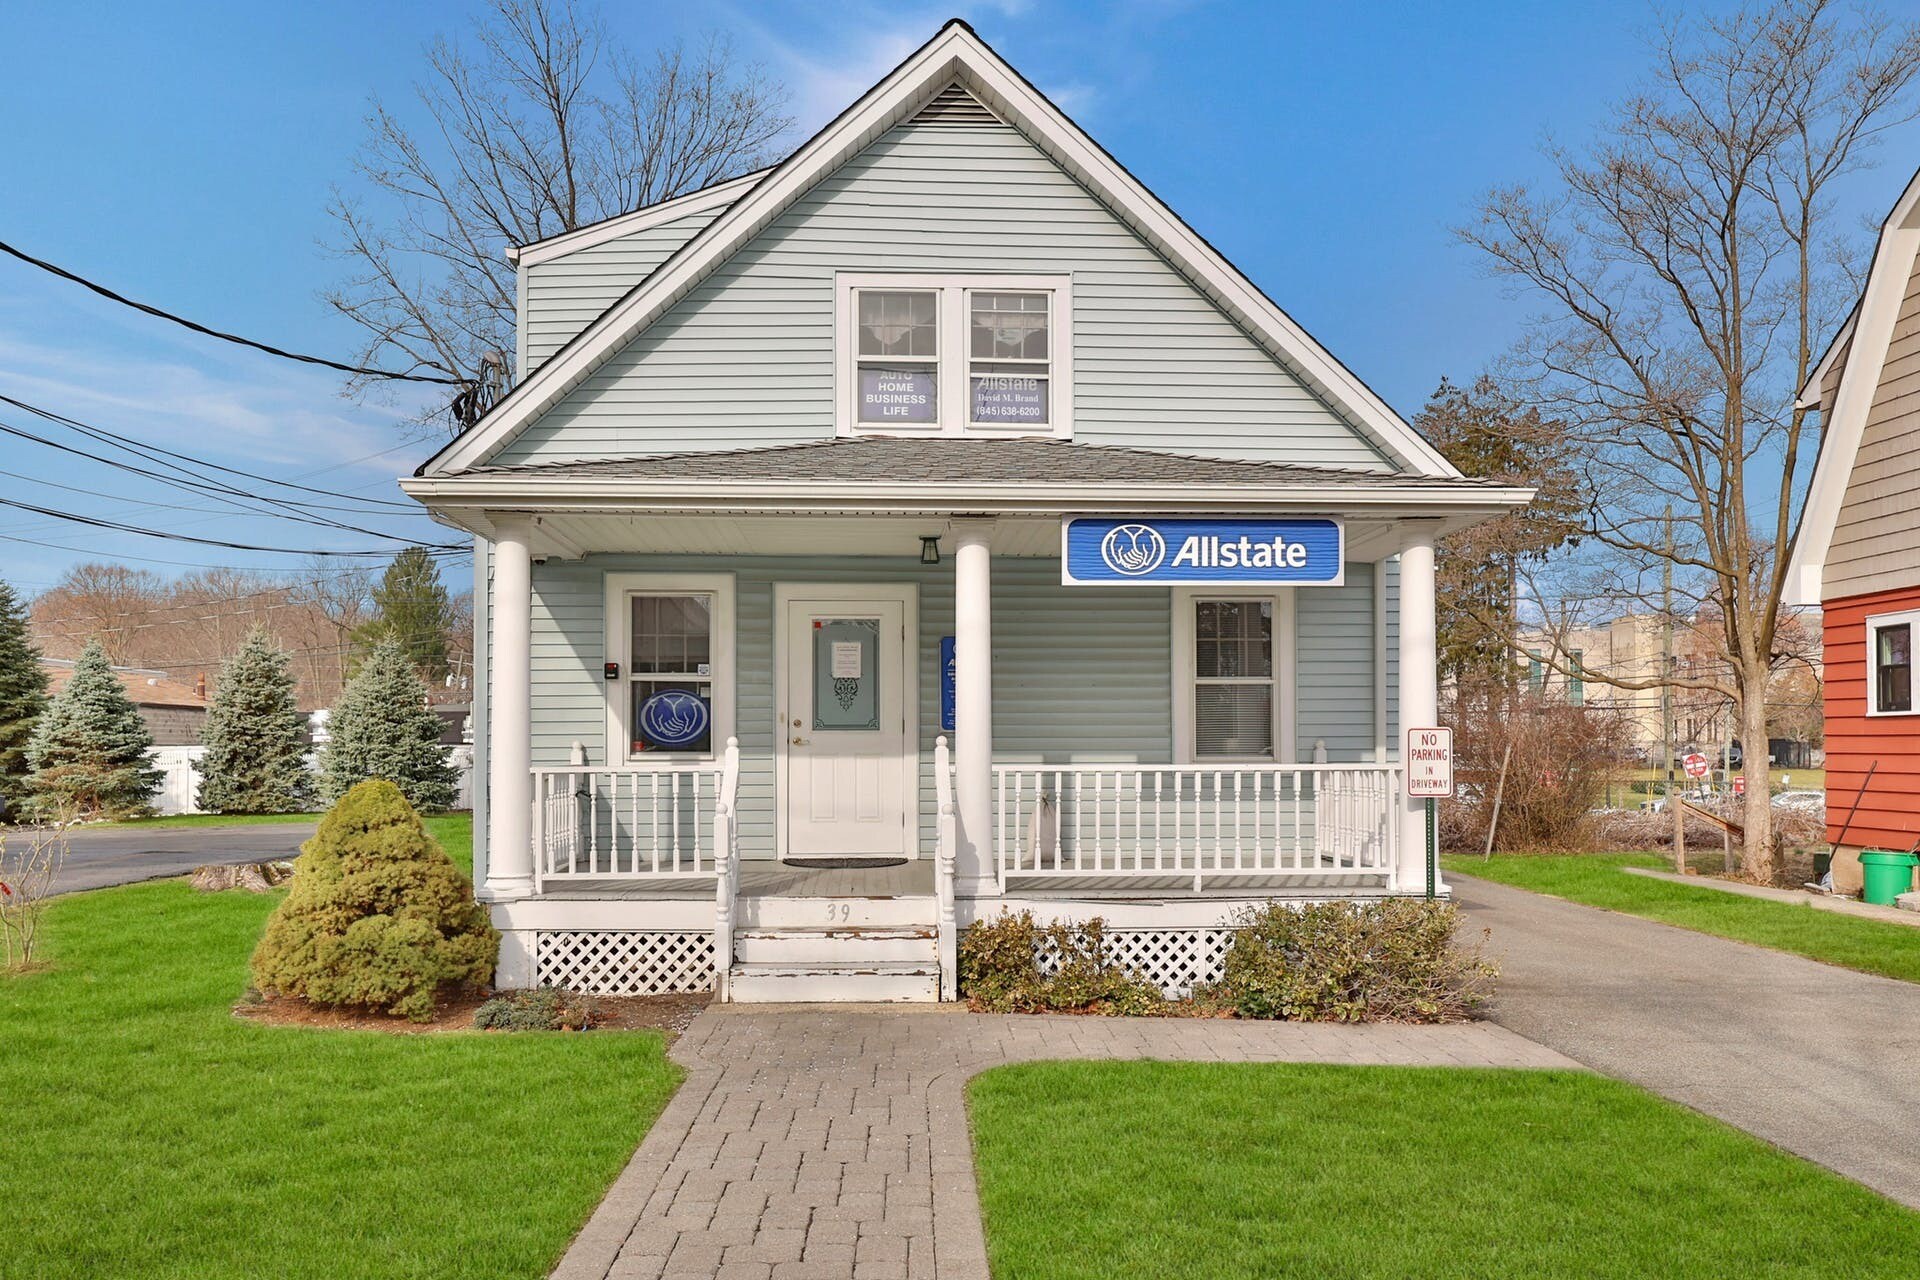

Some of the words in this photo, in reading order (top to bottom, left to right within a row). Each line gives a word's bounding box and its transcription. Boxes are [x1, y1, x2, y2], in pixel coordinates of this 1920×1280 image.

[880, 371, 912, 380] AUTO
[878, 382, 914, 392] HOME
[977, 377, 1038, 391] Allstate
[866, 394, 927, 404] BUSINESS
[978, 394, 1001, 402] David
[1003, 394, 1013, 402] M.
[1015, 394, 1039, 403] Brand
[883, 406, 909, 416] LIFE
[1171, 536, 1307, 568] Allstate
[1421, 734, 1437, 746] NO
[1411, 748, 1448, 761] PARKING
[1425, 766, 1434, 775] IN
[1411, 779, 1449, 789] DRIVEWAY
[827, 903, 850, 923] 39
